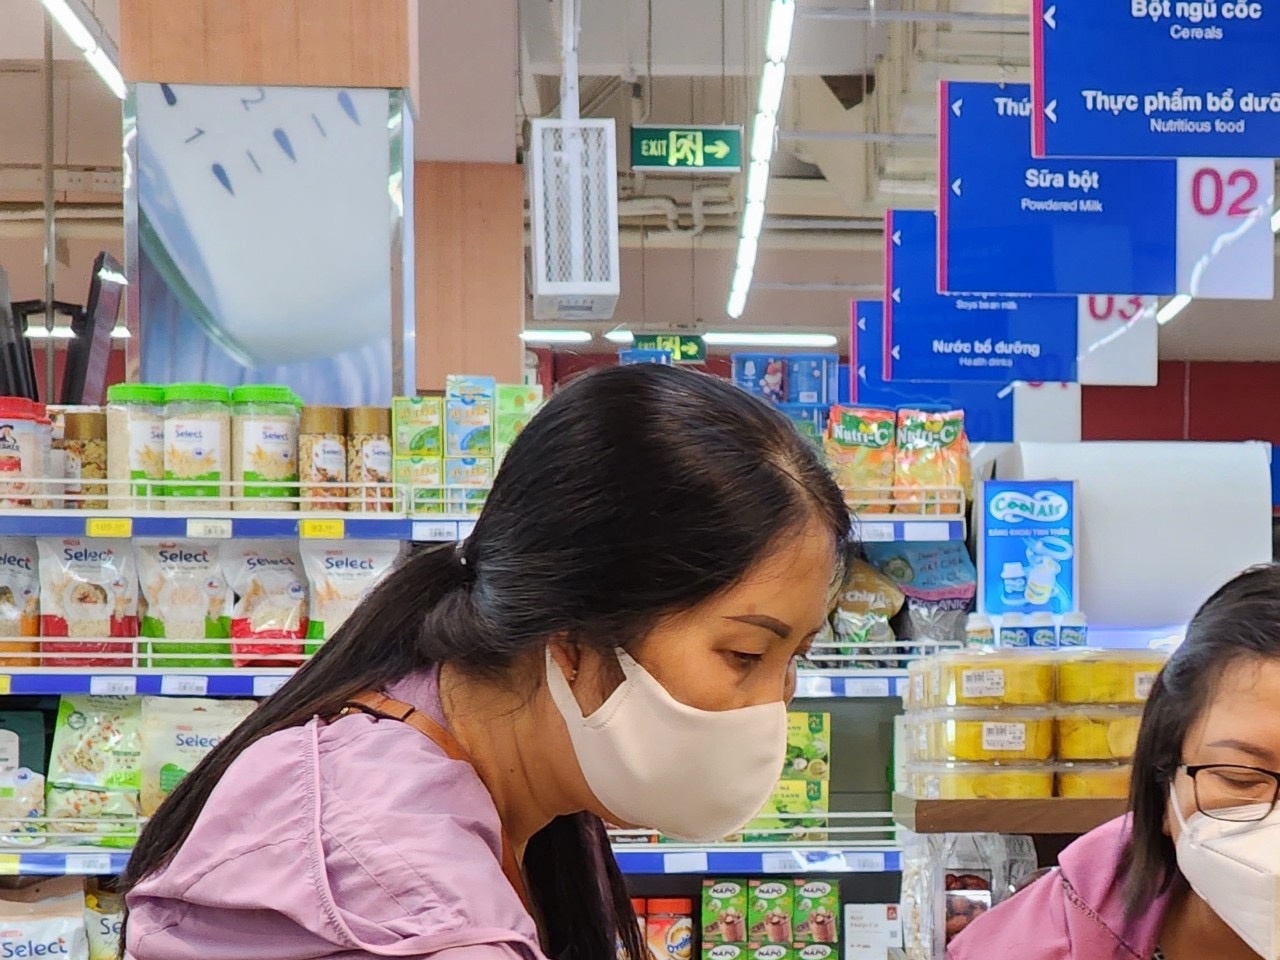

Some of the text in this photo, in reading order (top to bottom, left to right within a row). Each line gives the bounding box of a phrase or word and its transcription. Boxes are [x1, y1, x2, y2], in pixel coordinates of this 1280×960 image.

[1131, 0, 1171, 21] Bột
[1221, 0, 1262, 19] cốc
[1170, 25, 1223, 40] Cereals
[994, 97, 1033, 117] Thứ
[1082, 90, 1138, 116] Thực
[1144, 88, 1202, 115] phẩm
[1206, 88, 1234, 112] bổ
[1150, 118, 1245, 133] Nutritious food
[640, 138, 667, 157] EXIT
[1025, 168, 1100, 193] Sữa bột
[1191, 168, 1259, 217] 02
[1021, 198, 1103, 213] Powdered Milk
[932, 338, 1041, 357] Nước bổ dưỡng
[151, 430, 164, 440] Sel
[175, 429, 203, 439] Select
[262, 430, 289, 441] Select
[832, 423, 890, 445] Nutri-C
[896, 425, 955, 445] Nutri-C
[0, 552, 32, 570] lect
[63, 547, 113, 563] Select
[159, 549, 209, 563] Select
[247, 557, 295, 570] Select
[325, 556, 374, 570] Select
[1, 938, 68, 958] Select
